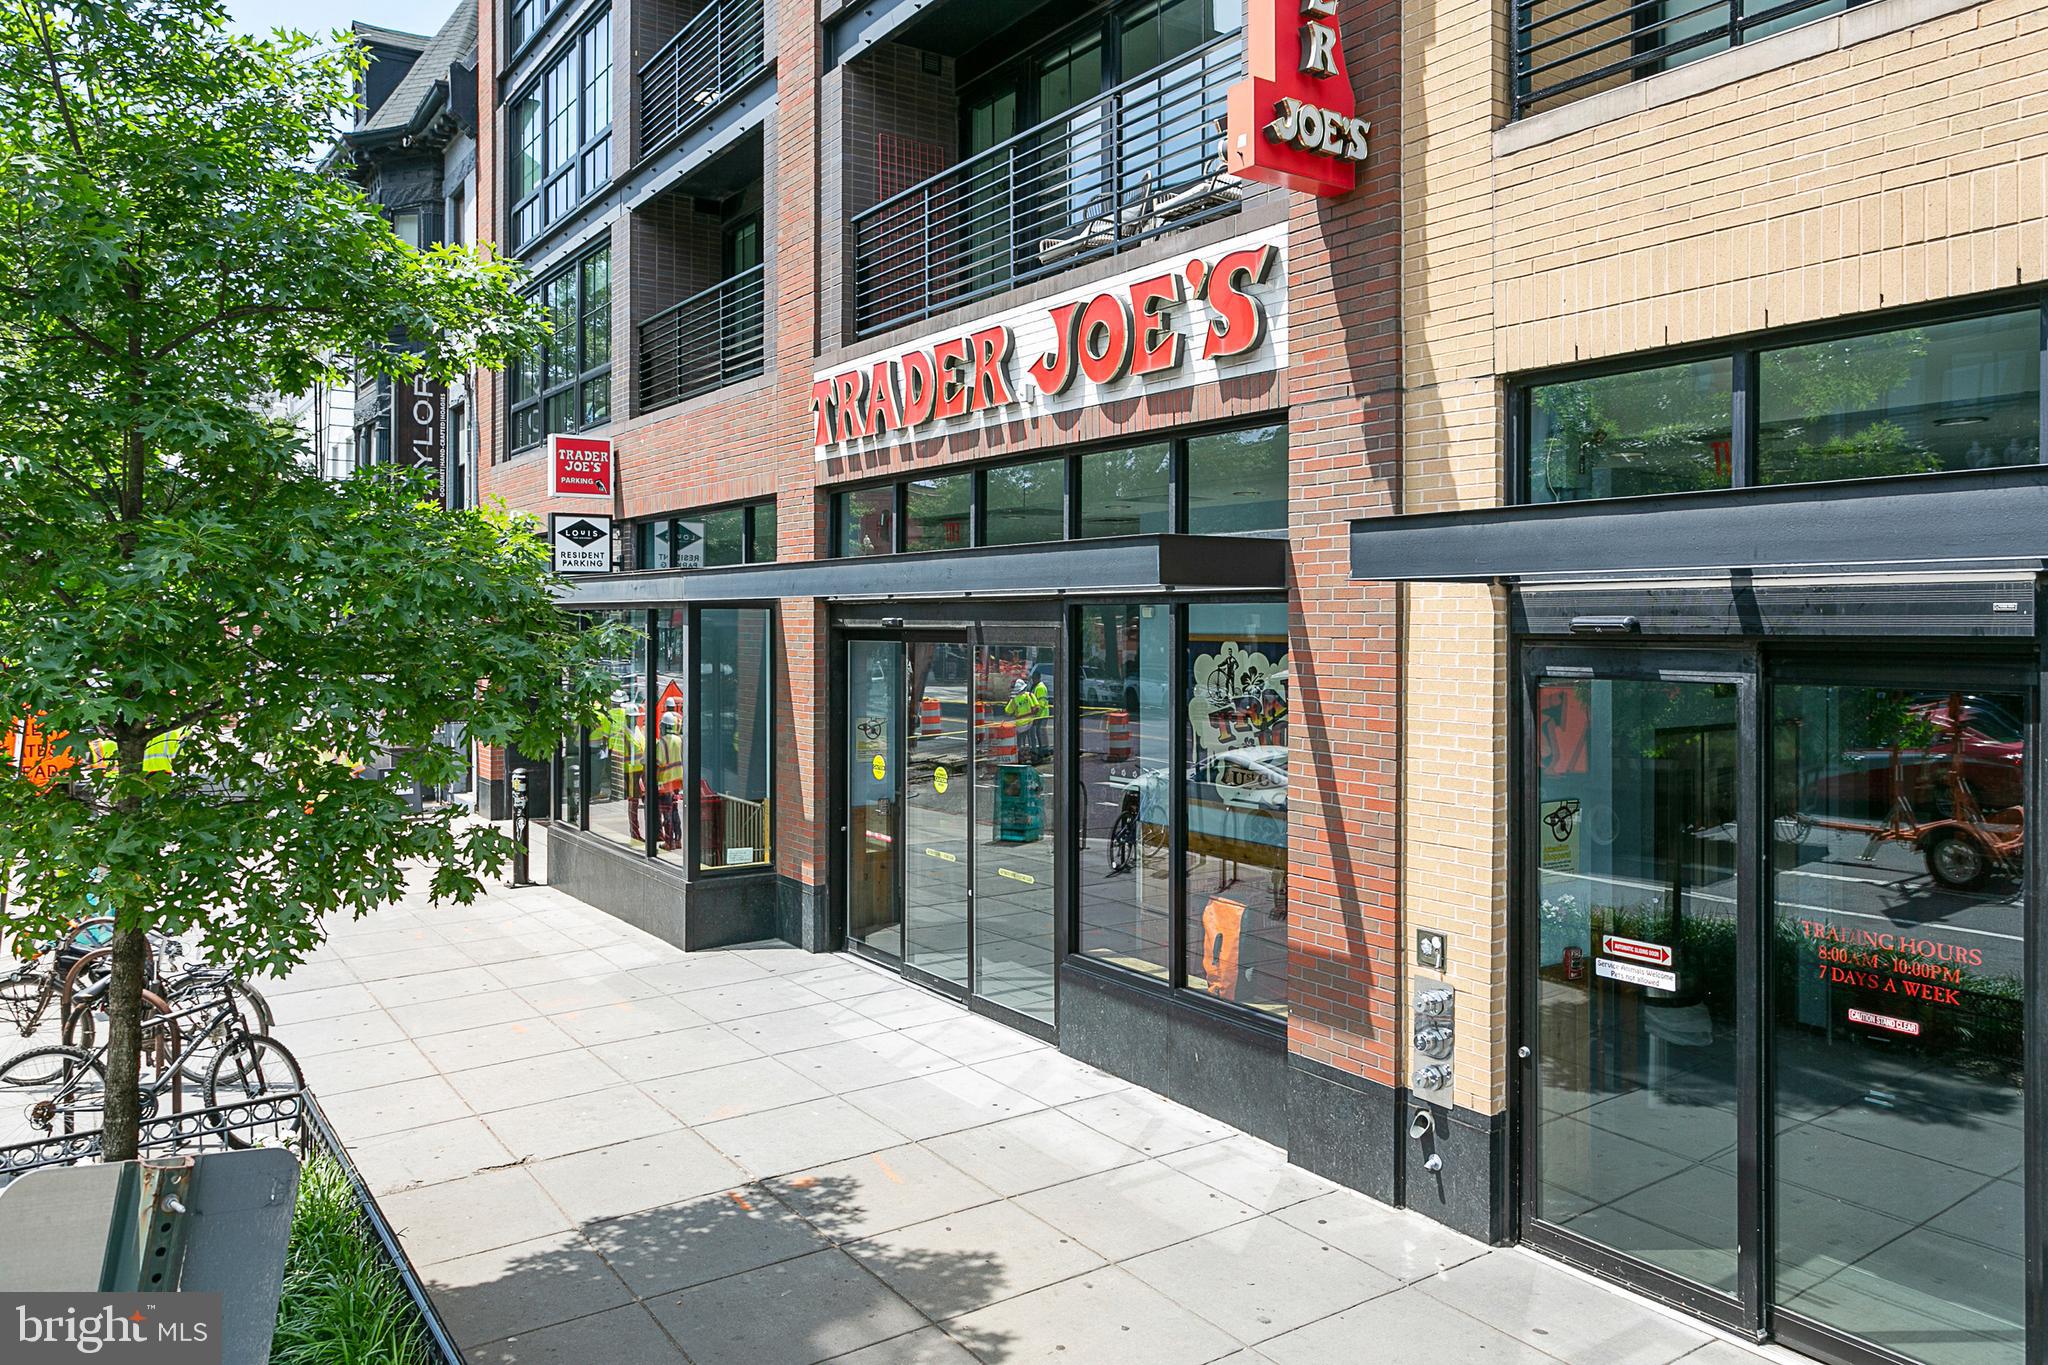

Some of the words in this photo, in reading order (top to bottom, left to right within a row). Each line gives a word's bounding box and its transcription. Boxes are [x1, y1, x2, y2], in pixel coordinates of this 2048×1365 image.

[1263, 97, 1371, 161] JOE'S
[810, 325, 1016, 446] TRADER
[1028, 244, 1279, 396] JOE'S
[558, 449, 608, 463] TRADER
[564, 461, 601, 473] JOE'S
[560, 477, 594, 485] PARKING
[565, 530, 599, 538] LOUIS
[560, 551, 605, 560] RESIDENT
[562, 559, 604, 568] PARKING
[1899, 936, 1983, 966] HOURS
[1597, 960, 1619, 970] Service
[1621, 964, 1645, 975] Animals
[1646, 969, 1674, 982] Welcome
[1893, 958, 1961, 985] 10:00PM
[1637, 976, 1660, 987] allowed
[1819, 964, 1827, 979] 7
[1831, 966, 1879, 989] DAYS
[1883, 977, 1897, 993] A
[1902, 980, 1961, 1006] WEEK
[1851, 1010, 1875, 1024] CAUTION
[1896, 1020, 1916, 1032] CLEAR
